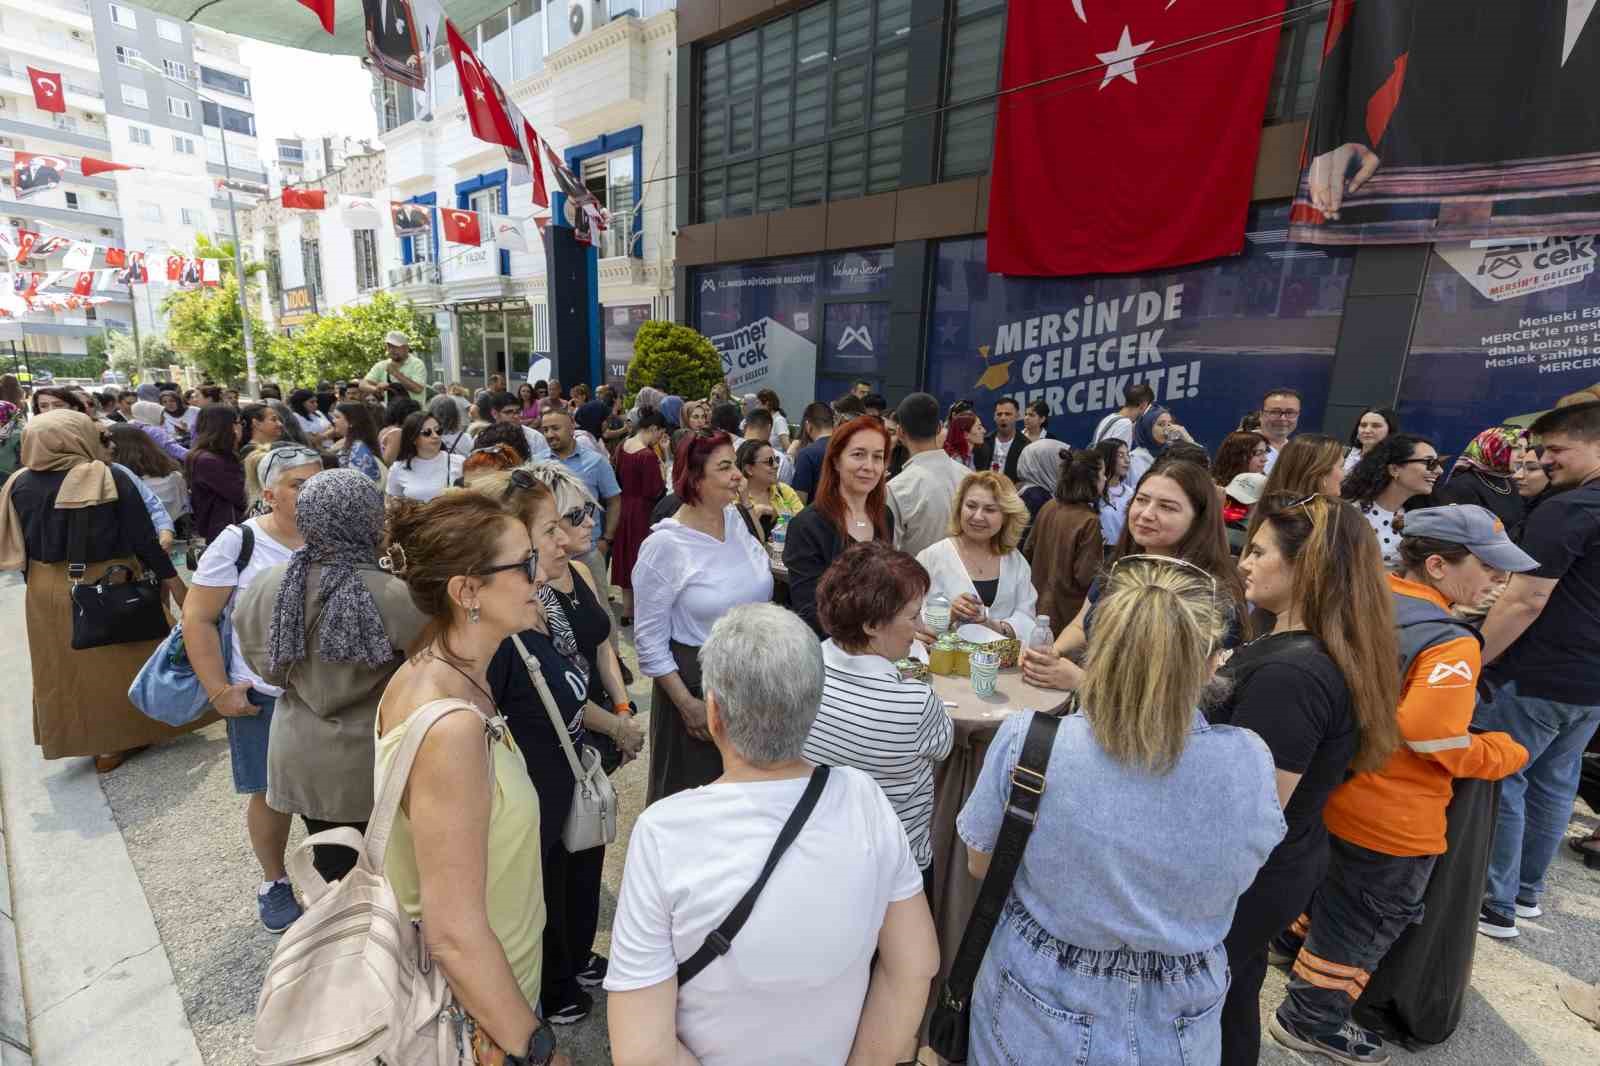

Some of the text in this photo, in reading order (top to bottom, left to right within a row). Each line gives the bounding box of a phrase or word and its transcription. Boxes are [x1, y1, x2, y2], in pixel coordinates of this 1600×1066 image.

[1534, 241, 1593, 269] cek
[994, 283, 1185, 356] MERSİN'DE
[1519, 310, 1577, 328] Mesleki
[733, 320, 768, 350] mer
[1481, 327, 1561, 345] MERCEK'le
[1488, 344, 1526, 356] daha
[1529, 338, 1571, 352] kolay
[738, 342, 769, 369] cek
[1022, 328, 1167, 385] GELECEK
[1485, 353, 1537, 369] Meslek
[1541, 346, 1588, 361] sahibi
